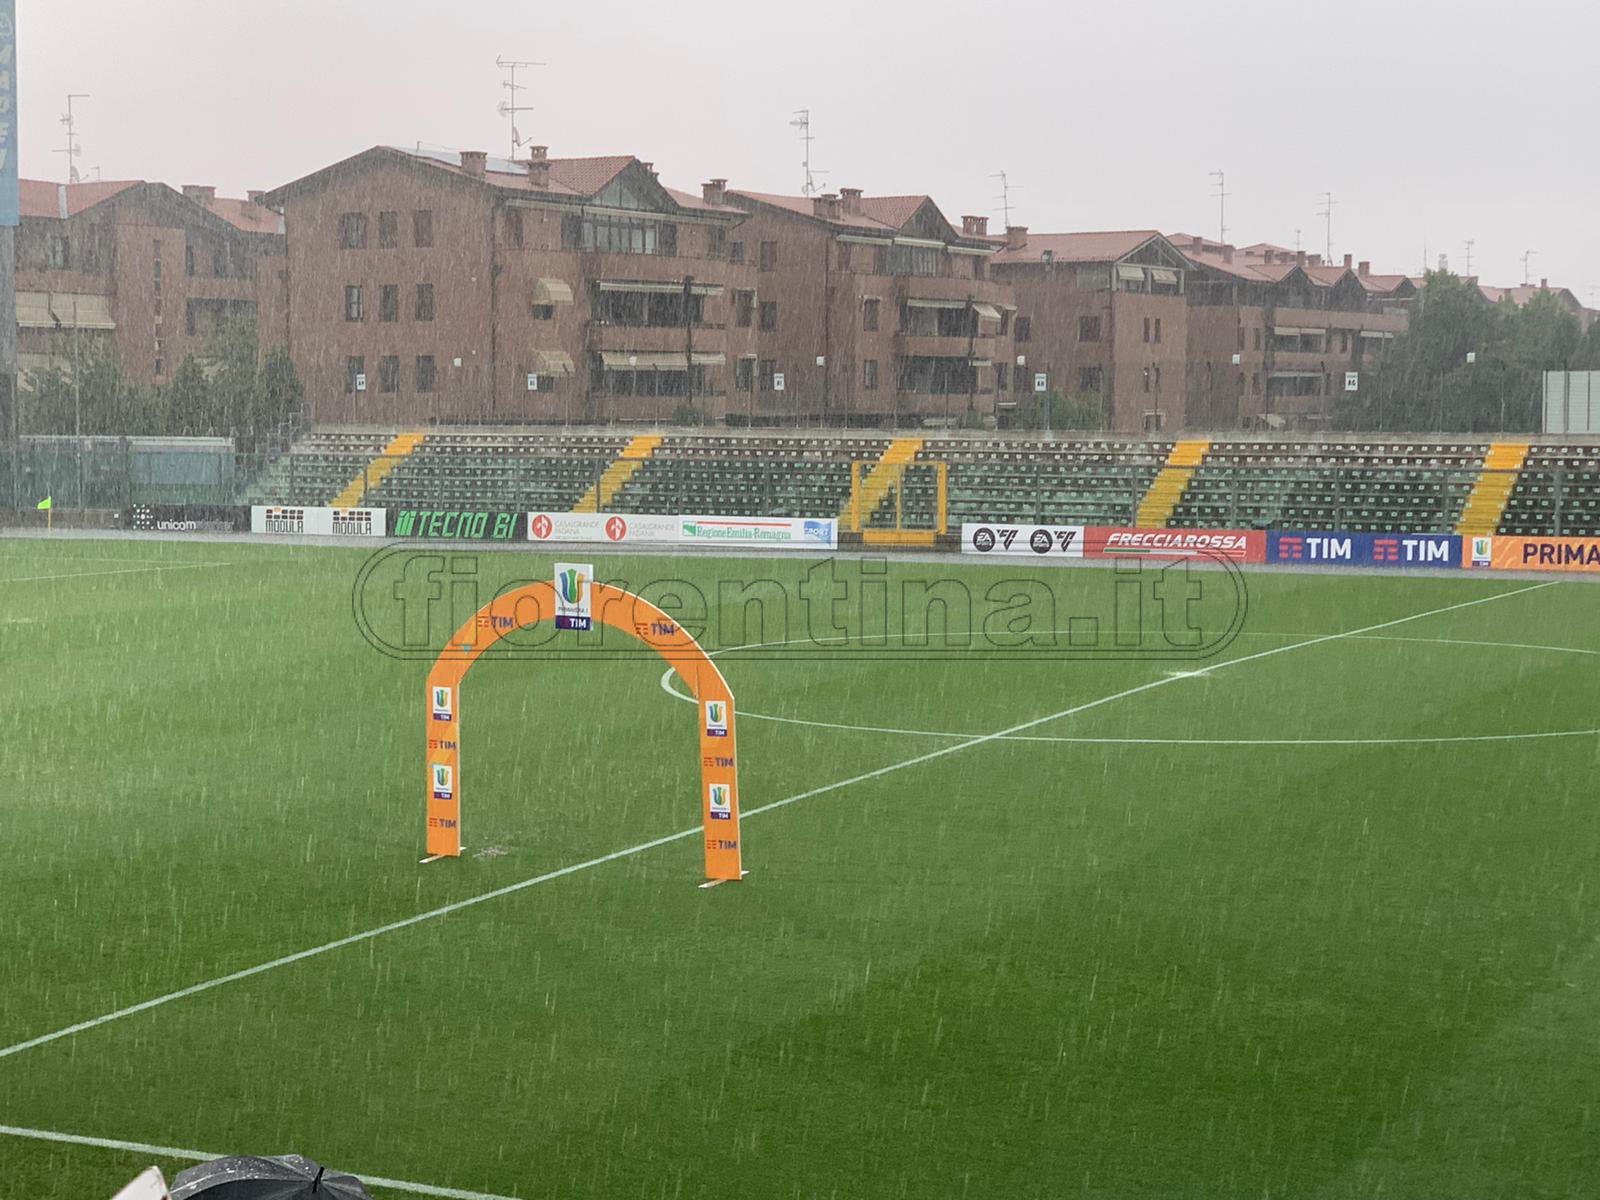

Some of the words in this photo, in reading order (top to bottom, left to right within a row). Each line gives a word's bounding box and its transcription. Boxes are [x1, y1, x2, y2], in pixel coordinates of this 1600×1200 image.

[266, 520, 303, 533] MODULA
[333, 522, 371, 535] MODULA
[418, 511, 488, 538] TECNO
[1107, 532, 1247, 549] FRECCIAROSSA
[1306, 537, 1351, 559] TIM
[1402, 539, 1449, 561] TIM
[491, 615, 513, 628] TIM
[569, 617, 587, 628] TIM
[651, 623, 675, 636] TIM
[440, 740, 456, 749] TIM
[715, 757, 733, 767] TIM
[439, 818, 456, 828] TIM
[719, 840, 737, 849] TIM
